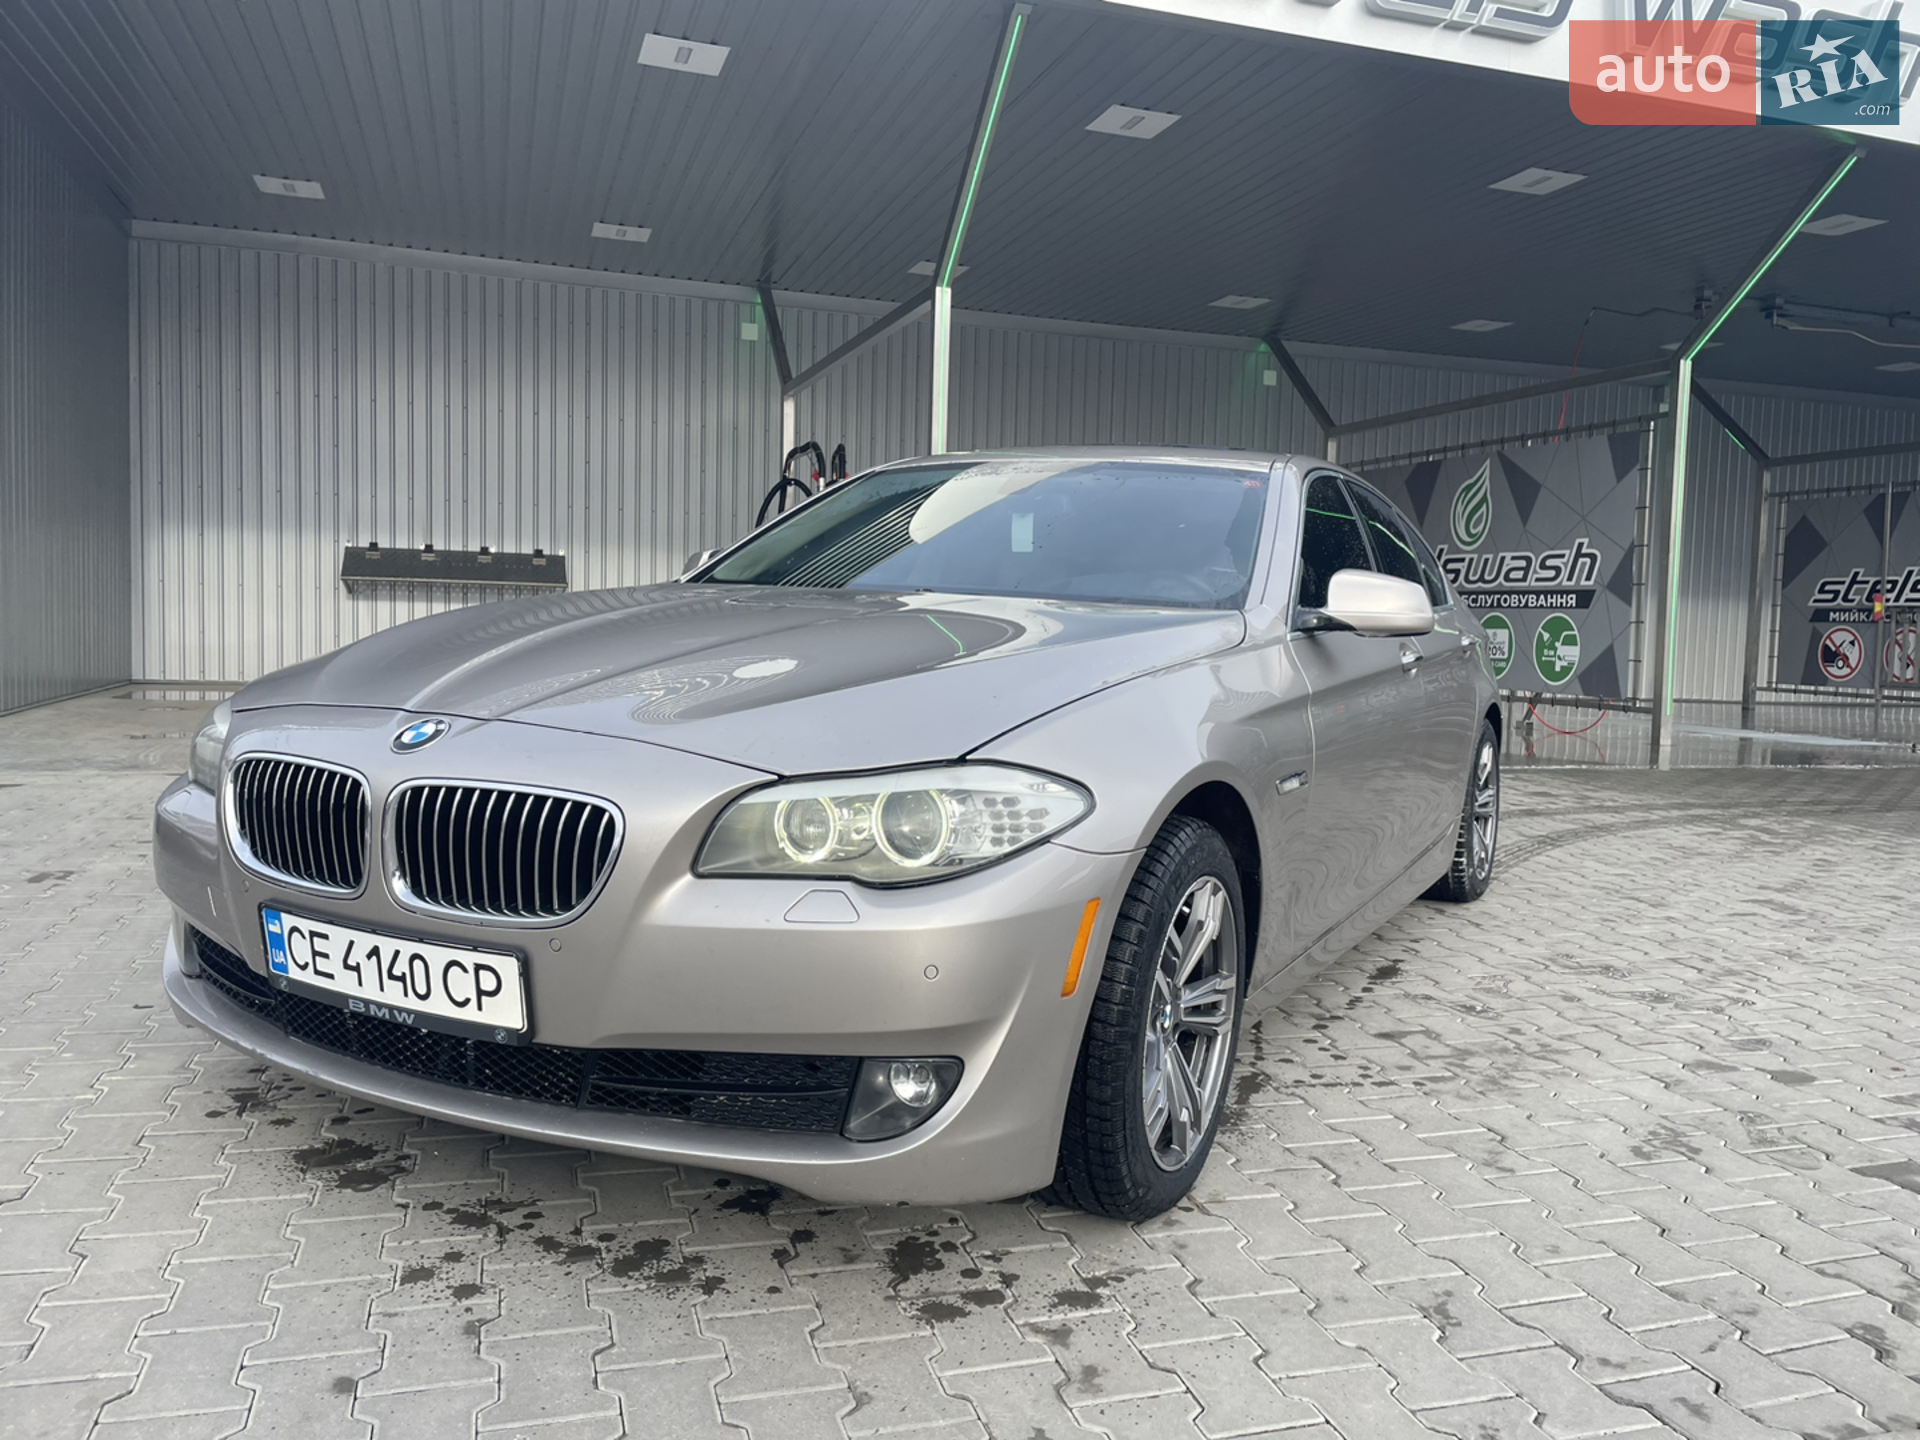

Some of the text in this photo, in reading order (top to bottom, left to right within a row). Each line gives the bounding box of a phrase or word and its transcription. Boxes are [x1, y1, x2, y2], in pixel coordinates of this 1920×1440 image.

[272, 949, 287, 966] UA
[287, 925, 503, 1012] CE 4140 CP
[348, 999, 416, 1024] BMW
